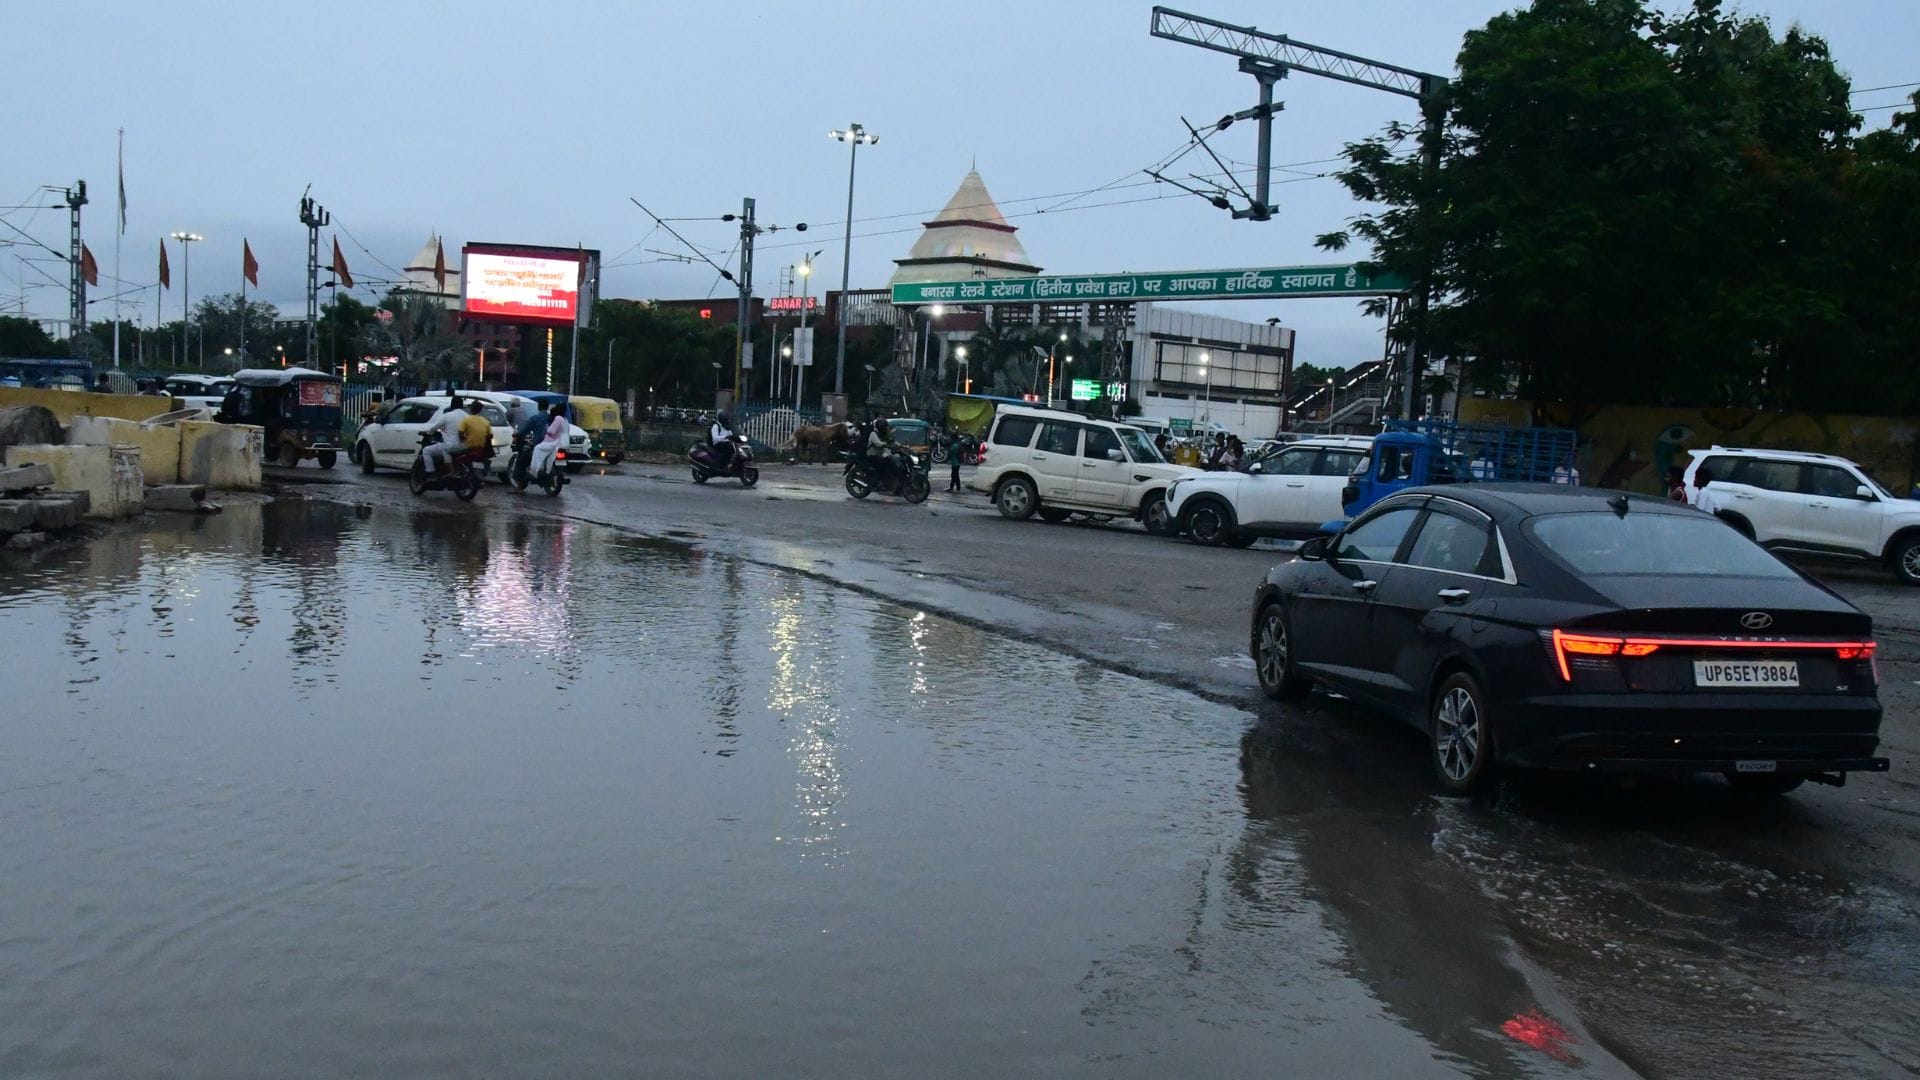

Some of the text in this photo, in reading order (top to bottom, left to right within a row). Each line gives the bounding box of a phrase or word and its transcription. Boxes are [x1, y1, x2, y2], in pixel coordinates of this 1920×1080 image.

[921, 286, 956, 298] बनारस
[960, 282, 986, 298] रेलवे
[991, 281, 1025, 297] स्टेशन
[1030, 279, 1072, 298] (द्वितीय
[1075, 278, 1105, 295] प्रवेश
[1108, 277, 1137, 297] द्वार)
[1143, 279, 1162, 292] पर
[1169, 277, 1218, 292] आपका
[1225, 271, 1274, 291] हार्दिक
[1281, 273, 1336, 289] स्वागत
[771, 297, 815, 310] BANARS
[1704, 665, 1798, 682] UP65EY3884
